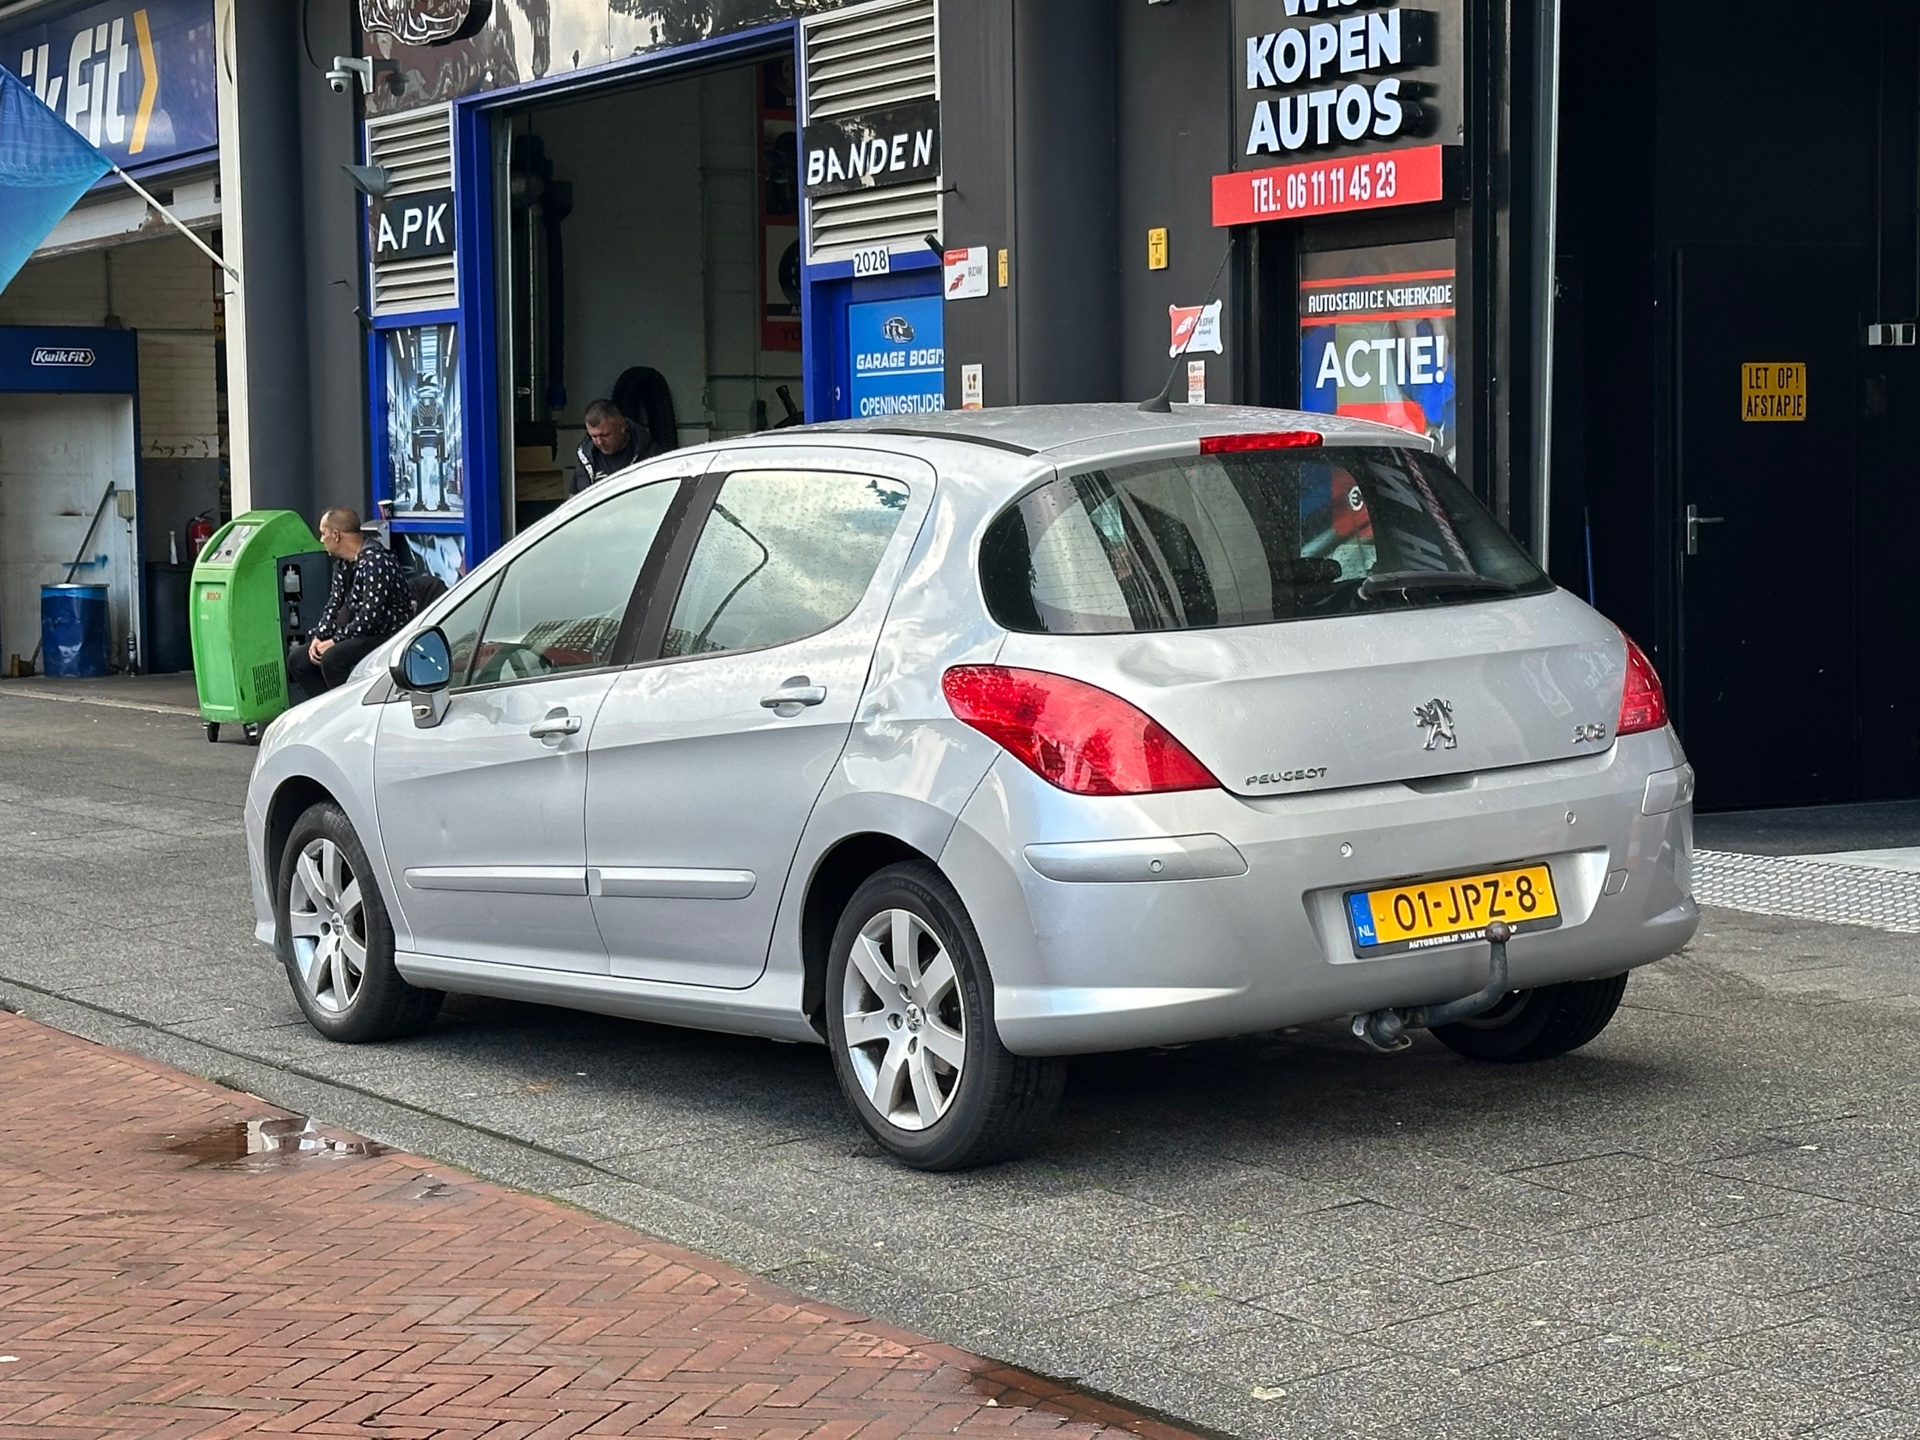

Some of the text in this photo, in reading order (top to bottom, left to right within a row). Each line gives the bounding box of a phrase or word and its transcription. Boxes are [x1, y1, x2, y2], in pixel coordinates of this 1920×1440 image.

[1246, 8, 1401, 90] KOPEN
[1246, 78, 1402, 155] AUTOS
[806, 128, 934, 187] BANDEN
[1252, 160, 1396, 213] TEL: 06 11 11 45 23
[377, 202, 448, 254] APK
[855, 249, 887, 273] 2028
[1308, 285, 1453, 313] AUTOSERVICE NEHERKADE
[856, 351, 906, 370] GARAGE
[1315, 335, 1445, 389] ACTIE!
[1748, 367, 1799, 389] LET OP!
[1746, 395, 1803, 416] AFSTAPJE
[1571, 722, 1606, 744] 308
[1244, 767, 1328, 786] PEUGEOT
[1393, 875, 1537, 931] 01-JPZ-8
[1358, 925, 1375, 938] NL
[1408, 934, 1459, 949] AUTOBEDRIJF
[1460, 931, 1477, 940] VAN
